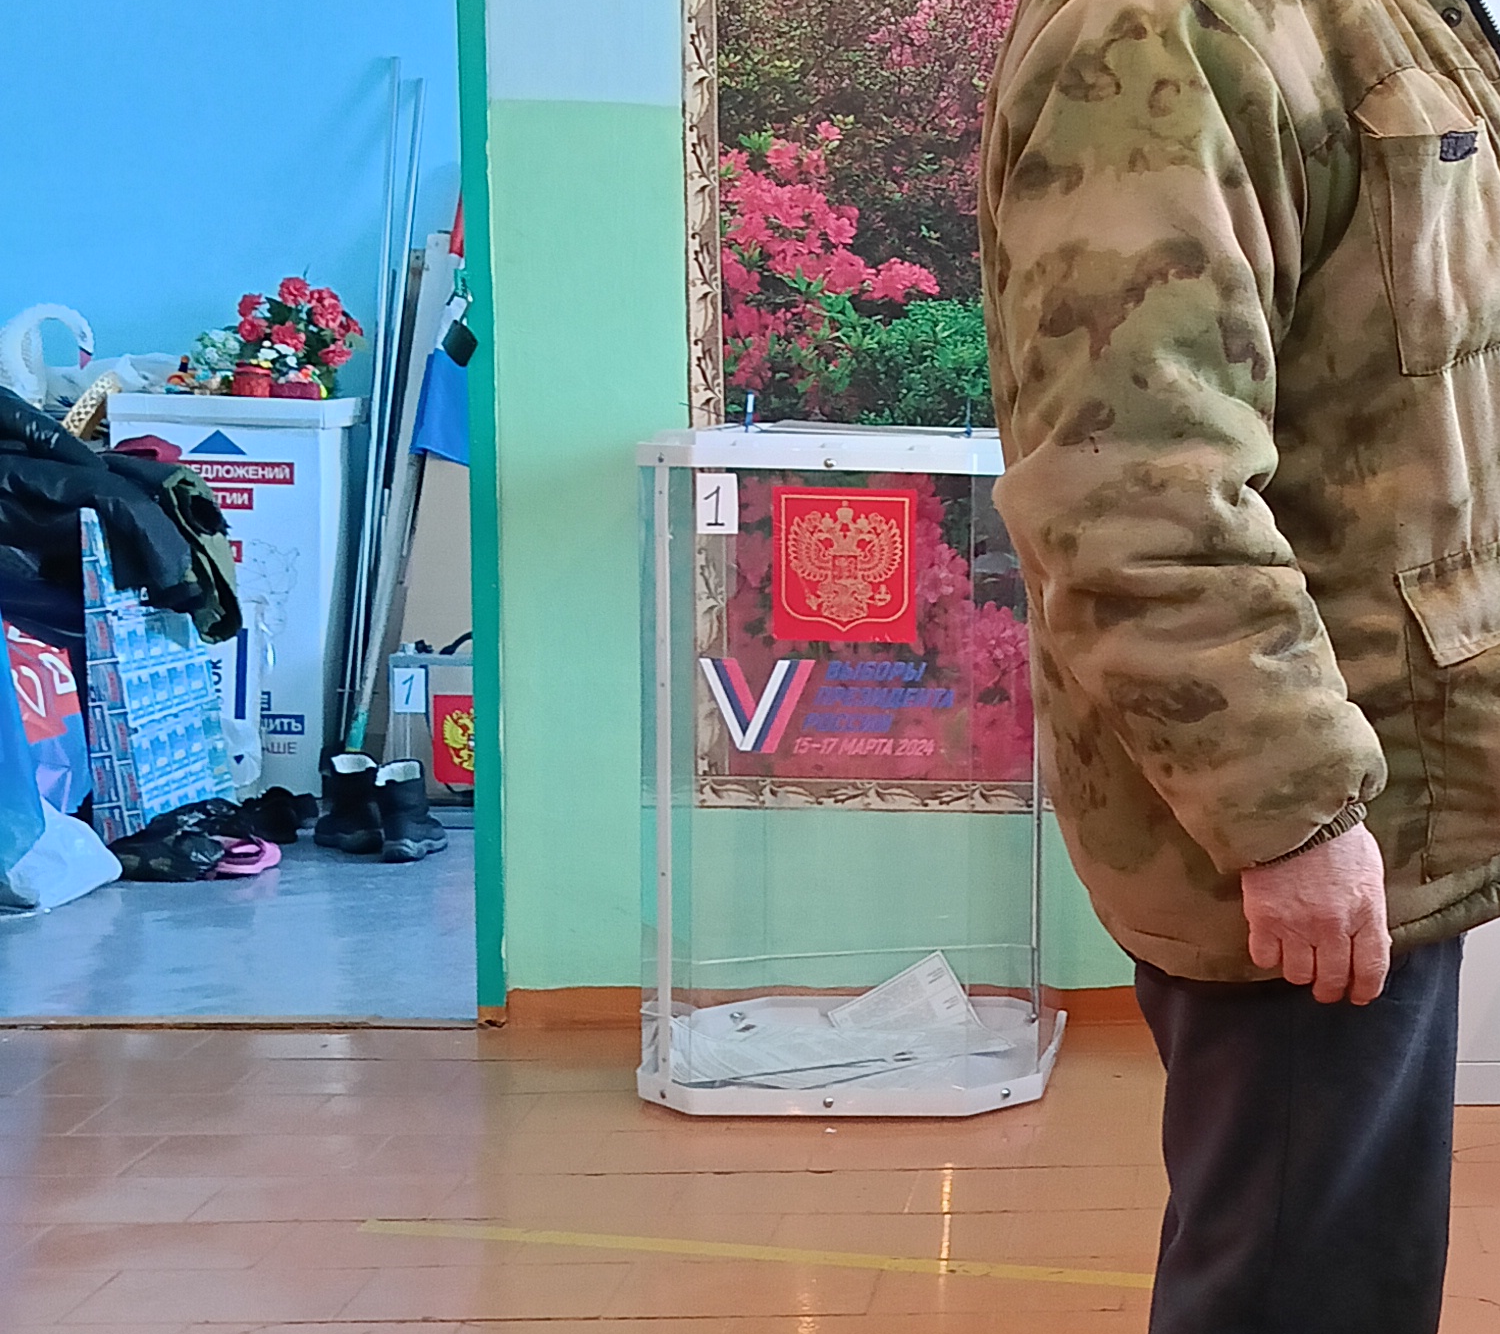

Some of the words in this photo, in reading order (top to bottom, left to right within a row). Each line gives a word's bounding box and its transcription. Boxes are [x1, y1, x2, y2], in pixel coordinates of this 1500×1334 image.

[186, 464, 290, 480] ЕДЛОЖЕНИЙ
[703, 485, 725, 526] 1
[825, 660, 927, 683] ВЫБОРЫ
[402, 674, 414, 705] 1
[812, 686, 955, 709] ПРЕЗИДЕНТА
[801, 712, 894, 733] РОССИИ
[838, 738, 894, 756] МАРТА
[893, 738, 936, 757] 2024
